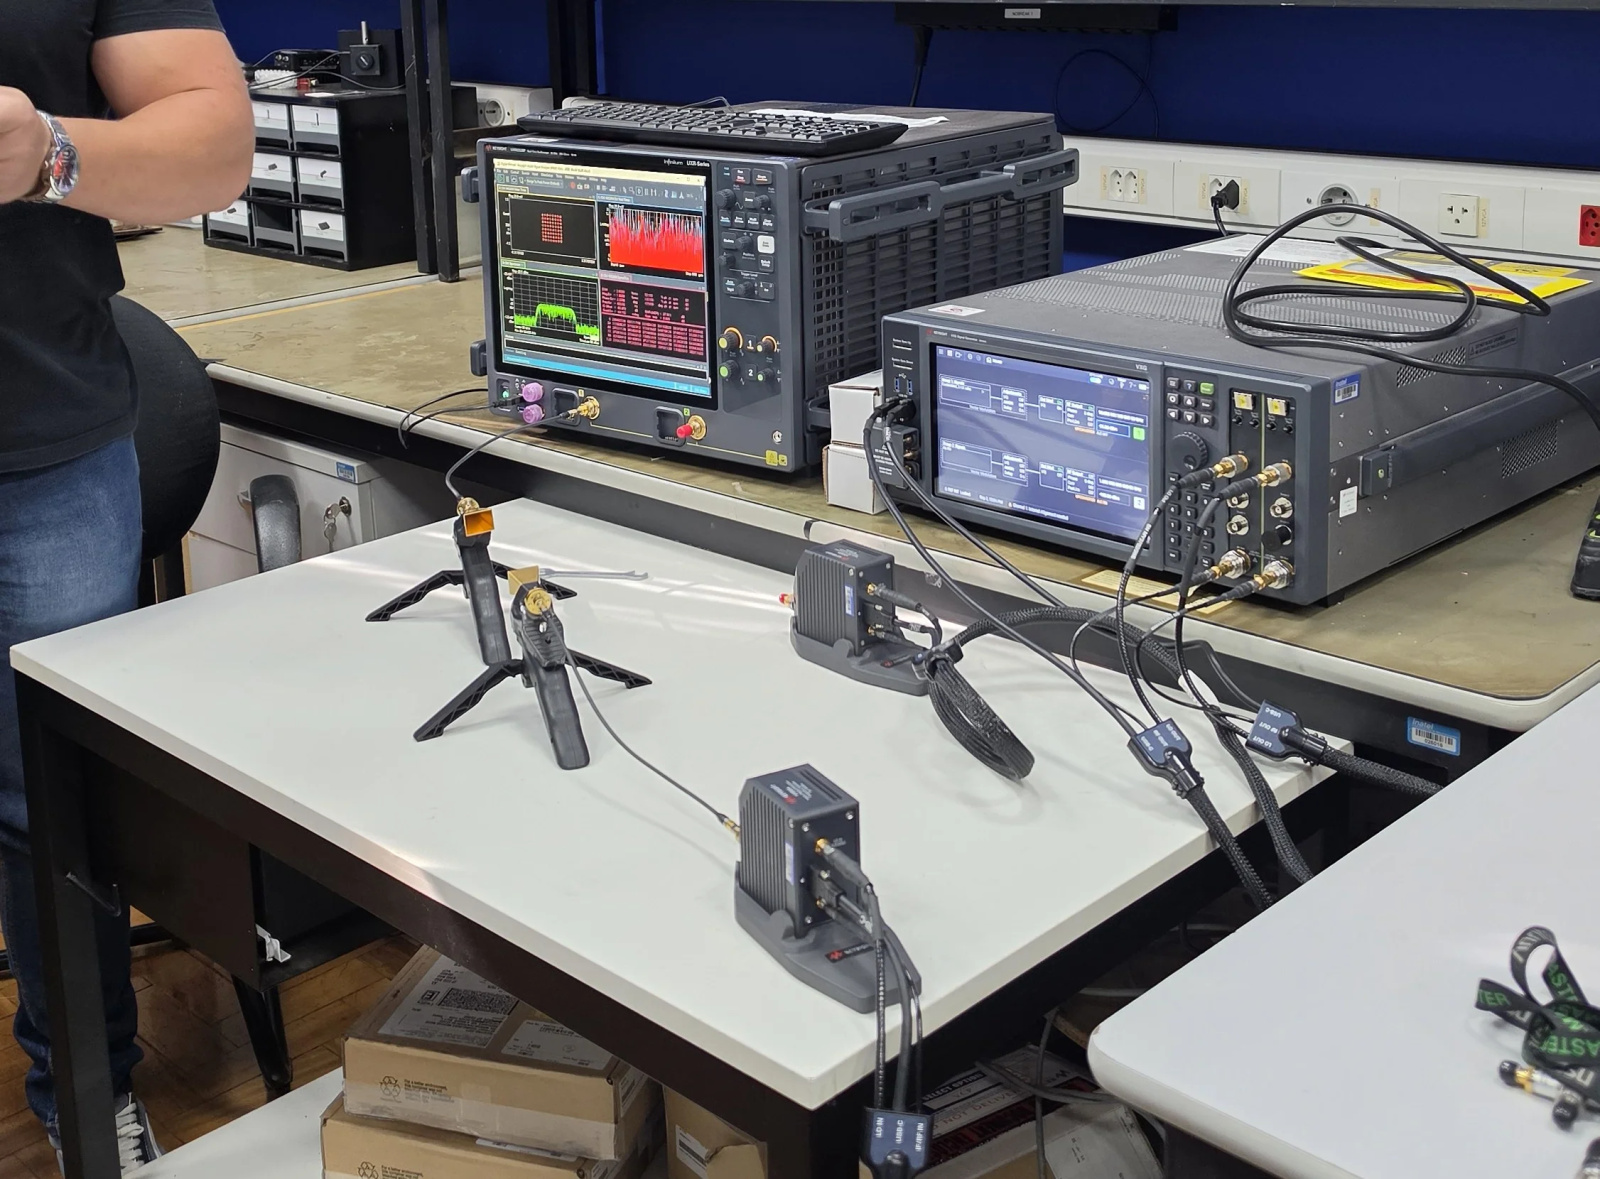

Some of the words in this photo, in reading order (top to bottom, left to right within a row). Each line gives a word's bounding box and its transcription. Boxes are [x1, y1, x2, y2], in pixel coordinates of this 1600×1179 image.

[1135, 363, 1148, 371] VXG
[1265, 707, 1282, 718] USB-C
[1259, 721, 1271, 731] OUT
[1412, 718, 1434, 730] Inatel
[1157, 735, 1169, 747] OUT
[1170, 730, 1181, 741] OUT
[1252, 735, 1265, 744] OUT
[922, 1086, 953, 1101] SELECT
[875, 1117, 885, 1126] IN
[943, 1111, 968, 1125] NOT
[875, 1126, 883, 1138] LO
[917, 1122, 924, 1131] IN
